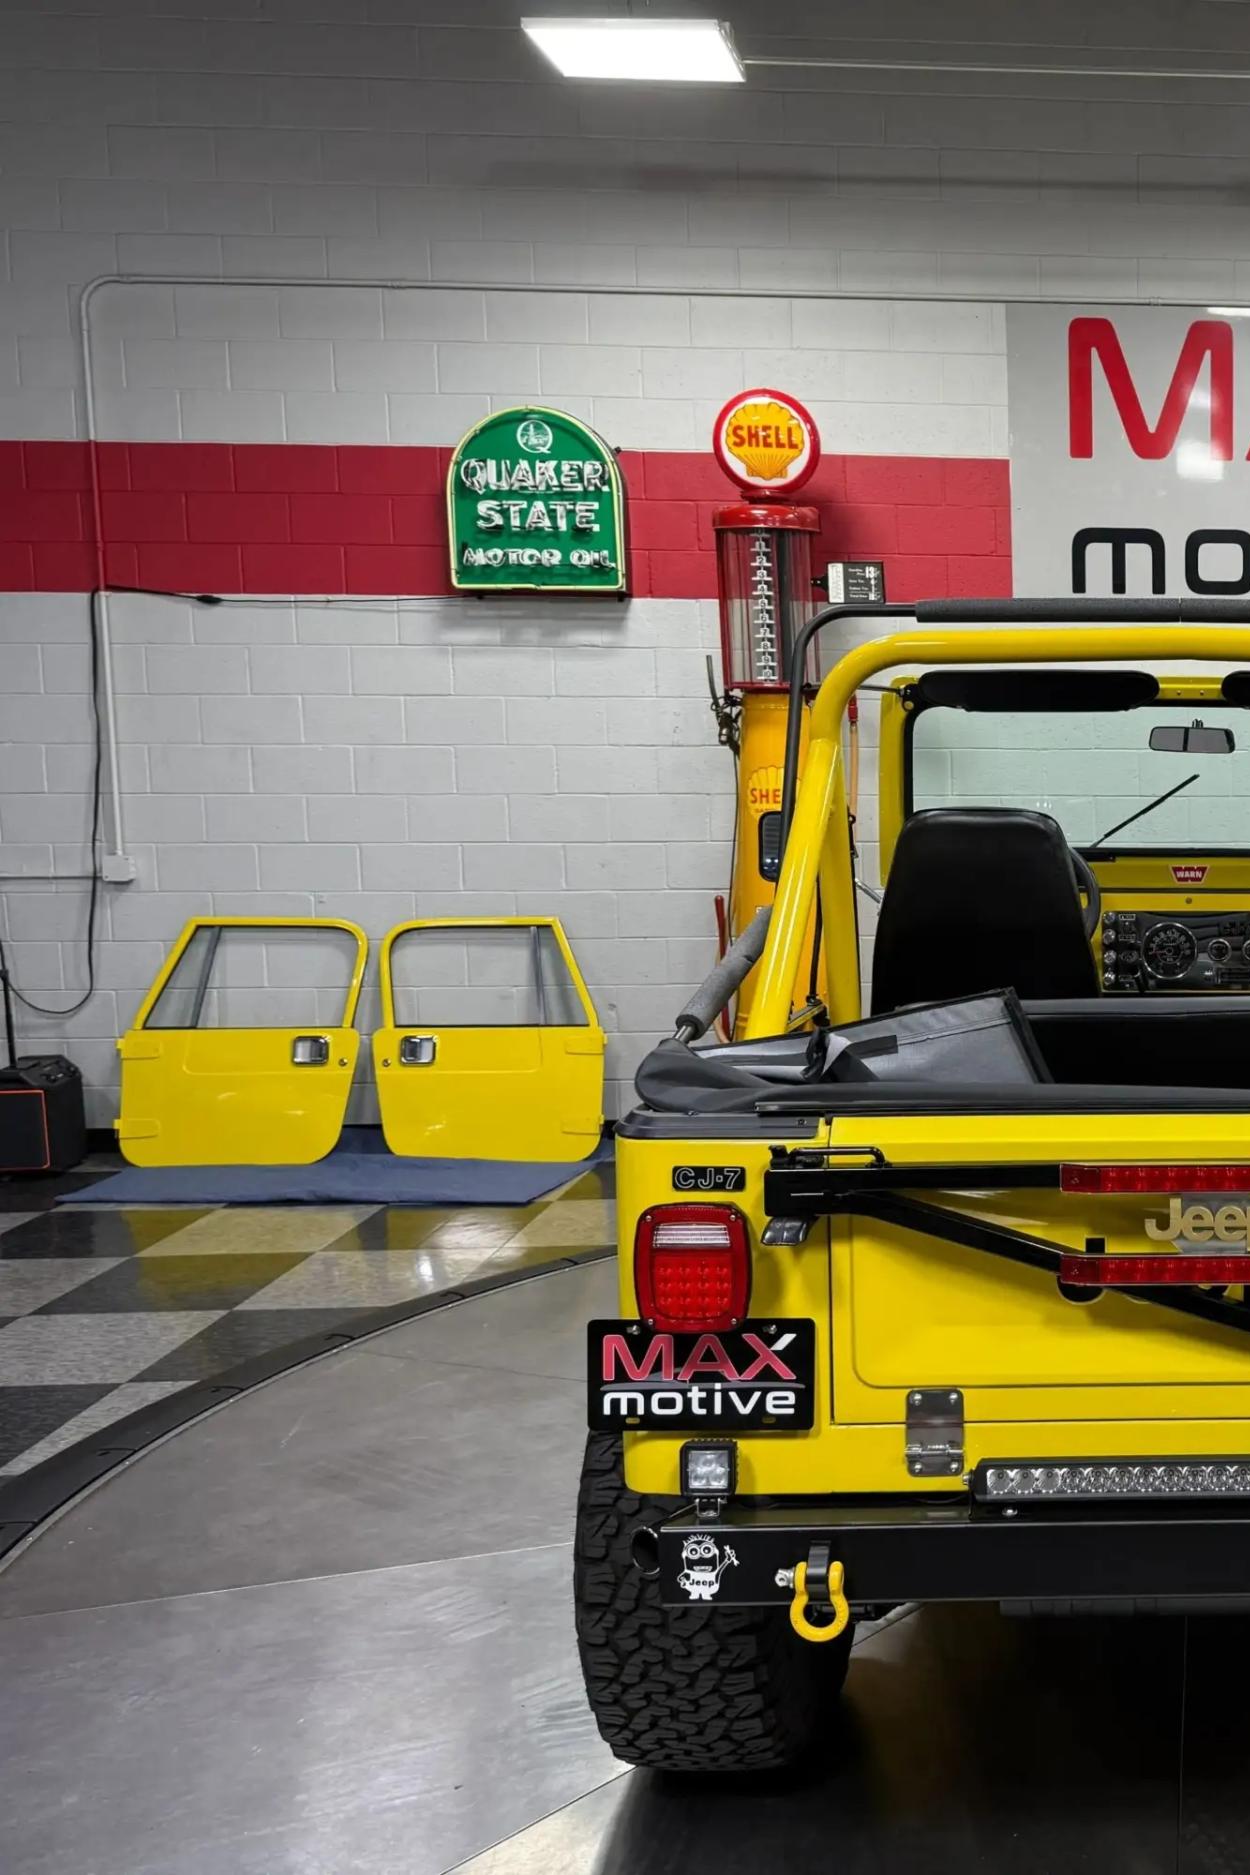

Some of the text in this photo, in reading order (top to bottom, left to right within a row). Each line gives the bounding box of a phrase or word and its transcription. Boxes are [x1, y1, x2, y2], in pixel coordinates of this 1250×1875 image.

[732, 424, 800, 450] SHELL
[461, 458, 609, 494] QUAKER
[476, 501, 600, 533] STATE
[463, 548, 616, 568] MOTOR OIL
[750, 788, 781, 804] SHE
[1176, 870, 1203, 879] WARN
[602, 1333, 797, 1380] MAX
[603, 1383, 796, 1416] motive
[689, 1578, 714, 1588] Jeep
